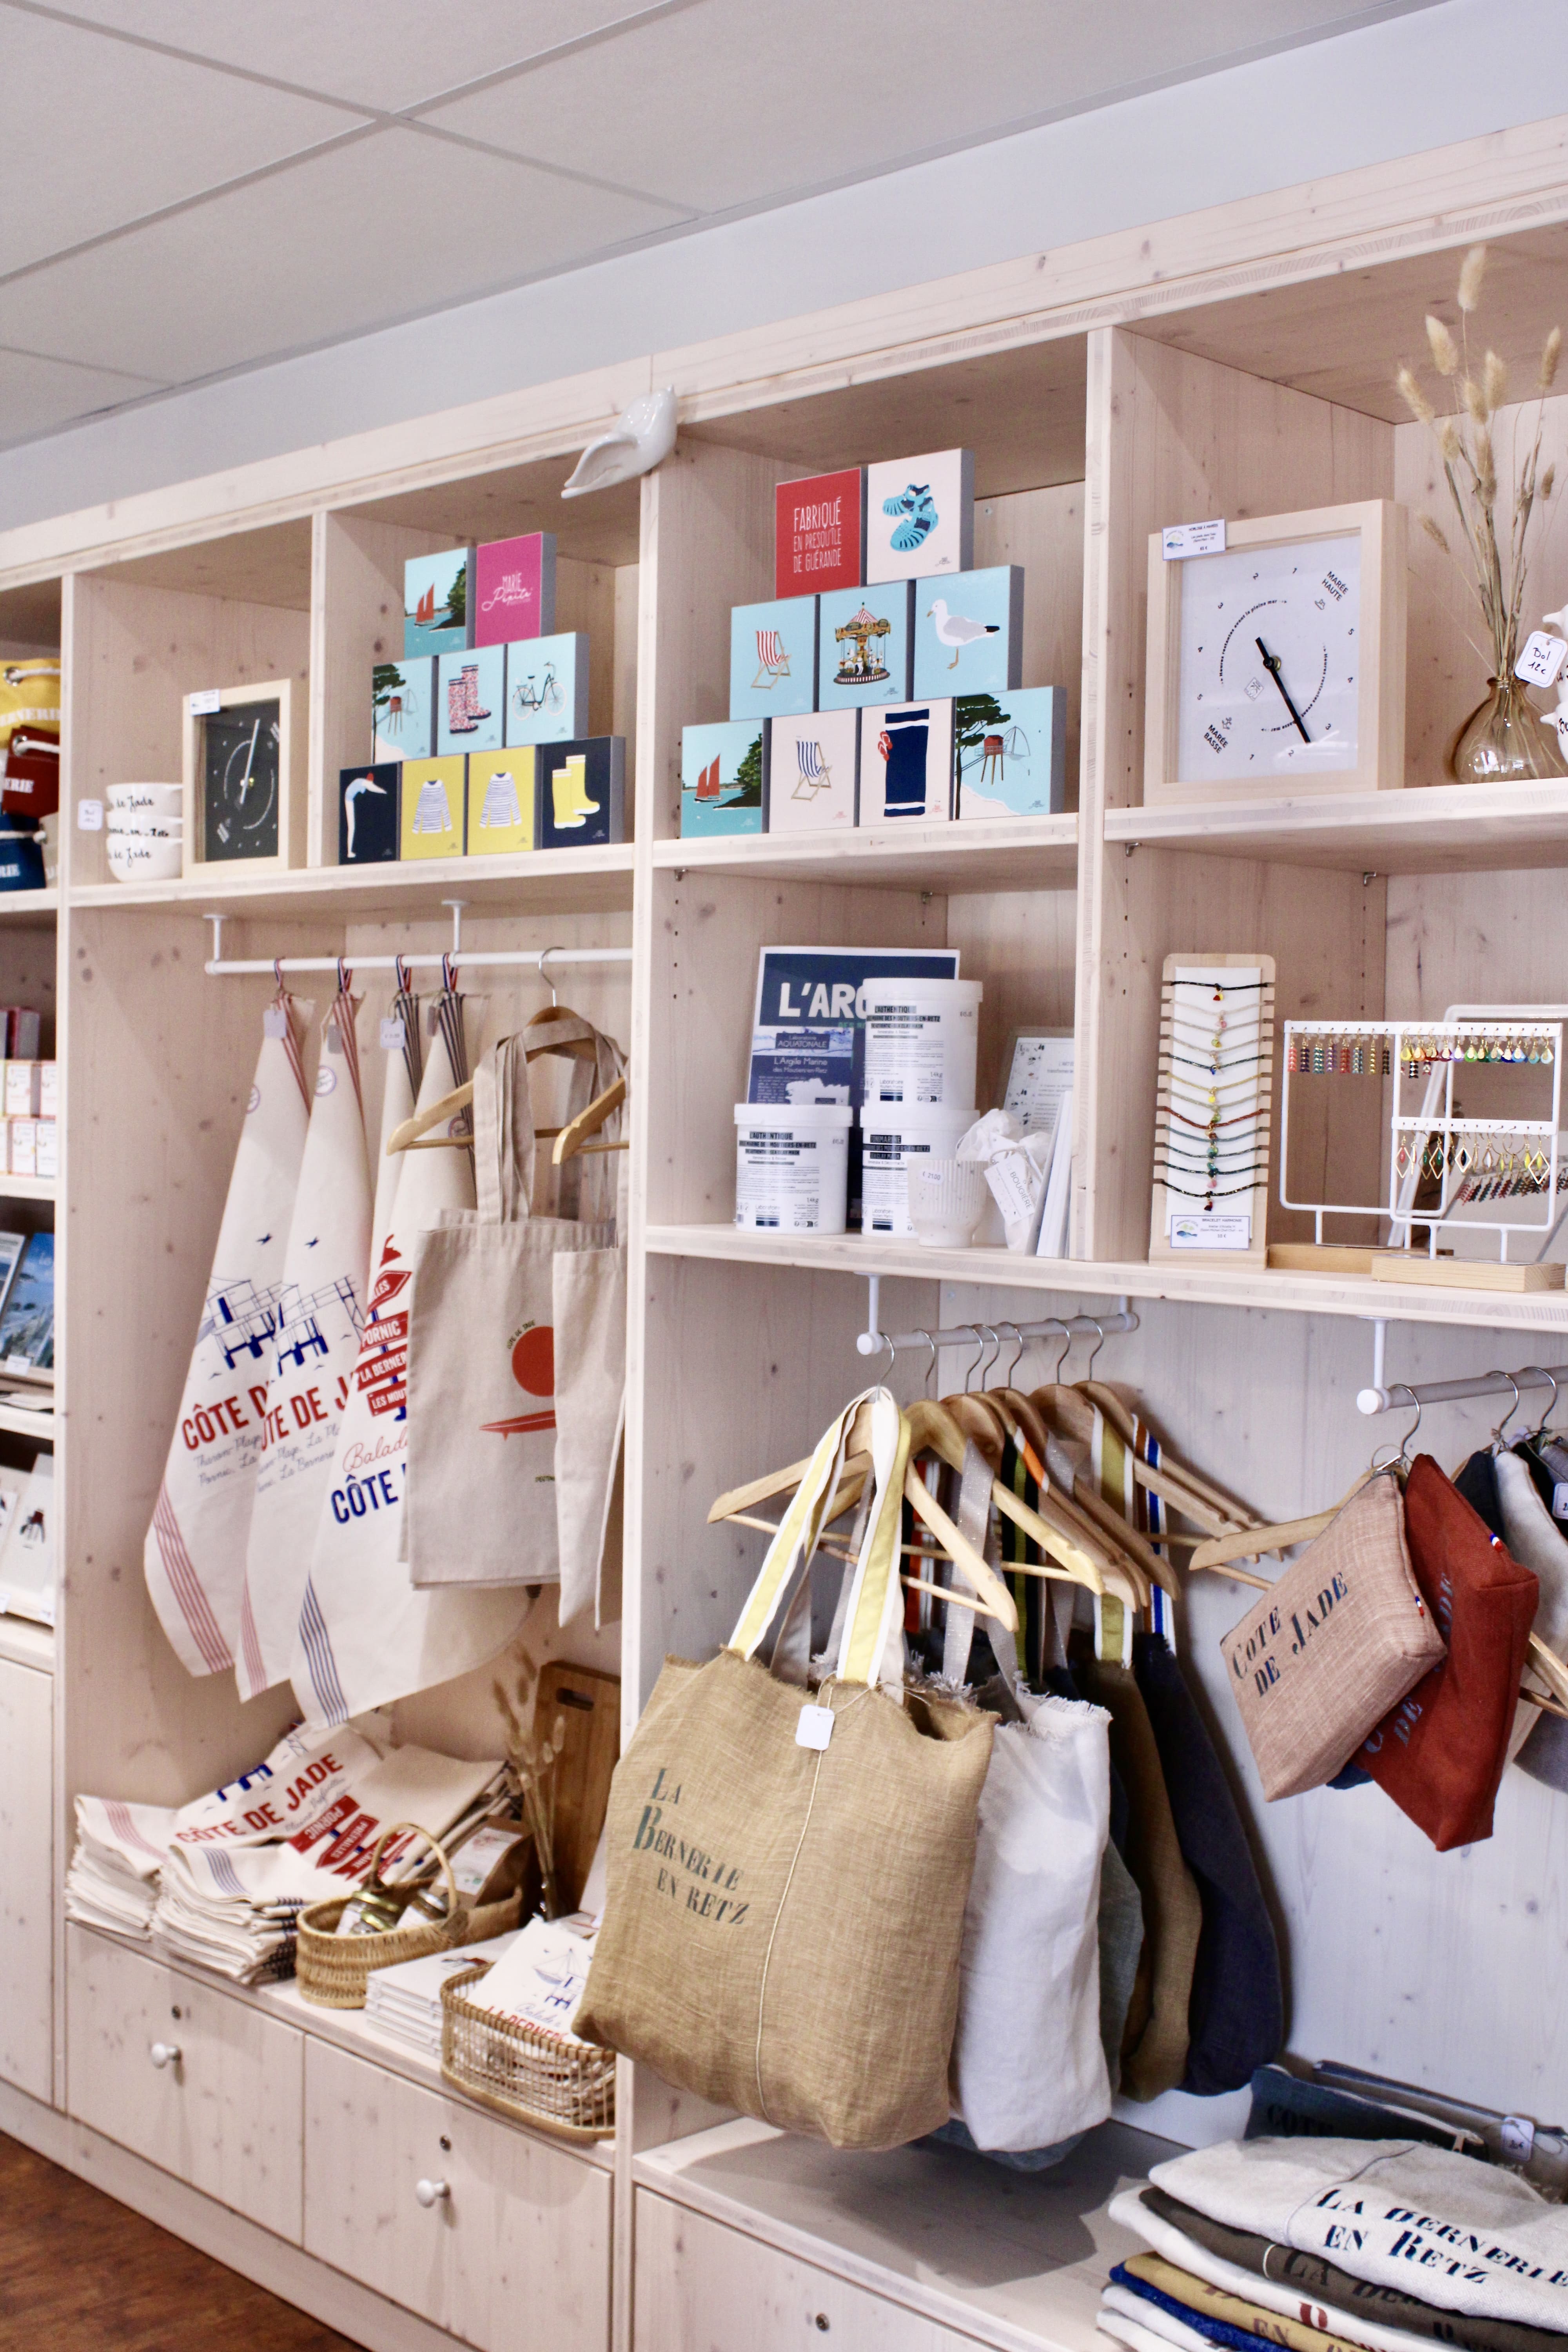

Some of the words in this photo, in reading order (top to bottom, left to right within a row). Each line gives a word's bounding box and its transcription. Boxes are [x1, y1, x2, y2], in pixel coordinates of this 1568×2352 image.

[794, 535, 802, 552] EN
[794, 555, 802, 573] DE
[806, 548, 841, 571] GUÉRANDE
[1321, 579, 1343, 601] HAUTE
[1327, 571, 1348, 595] MARÉE
[1533, 647, 1551, 661] Bol
[1204, 732, 1222, 754] BASSE
[1208, 724, 1228, 748] MARÉE
[1010, 1172, 1031, 1209] BOUGIÈRE
[362, 1320, 401, 1347] PORNIC
[360, 1367, 372, 1383] LA
[290, 1387, 328, 1429] DE
[372, 1396, 387, 1410] LES
[182, 1396, 249, 1450] CÔTE
[331, 1469, 399, 1524] CÔTE
[1254, 1656, 1281, 1698] DE
[1291, 1572, 1348, 1655] JADE
[176, 1820, 246, 1843] CÔTE
[242, 1802, 285, 1831] DE
[285, 1753, 344, 1811] JADE
[657, 1868, 679, 1899] EN
[686, 1886, 750, 1925] RETZ
[1323, 2225, 1368, 2251] EN
[1388, 2230, 1490, 2284] RETZ
